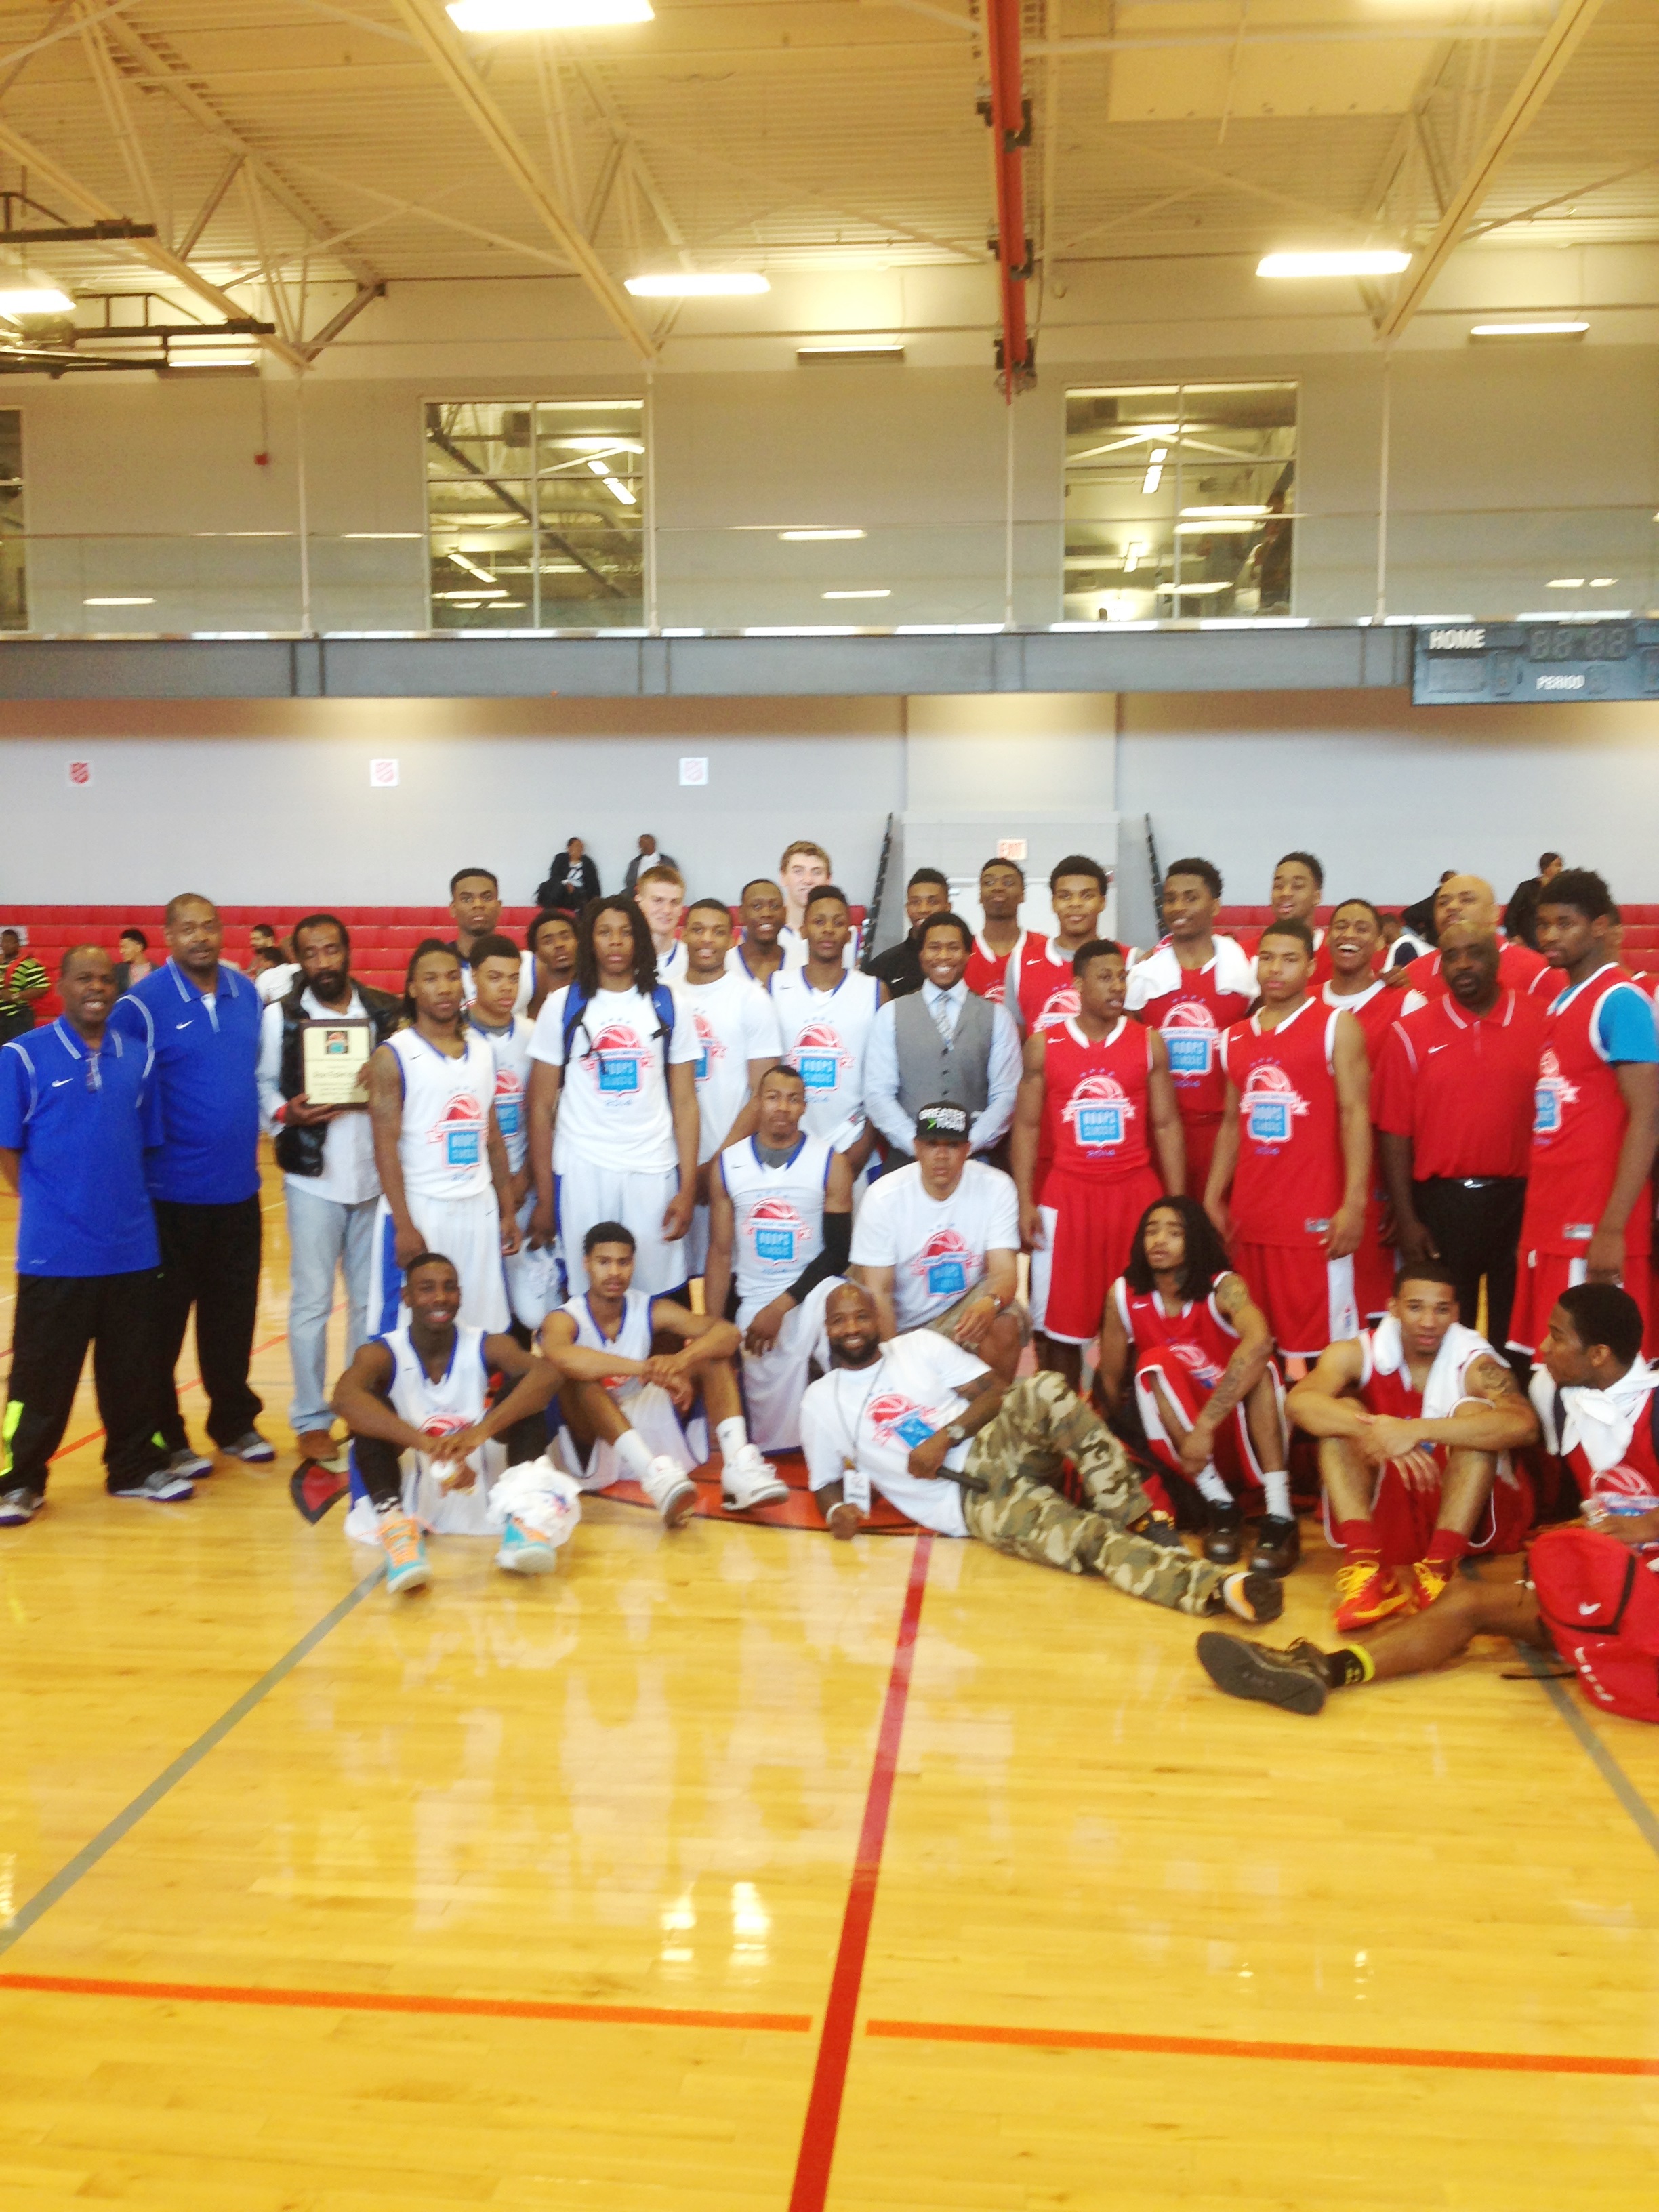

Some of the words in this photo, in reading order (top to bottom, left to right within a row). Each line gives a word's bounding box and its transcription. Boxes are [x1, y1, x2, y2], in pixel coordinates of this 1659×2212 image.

[1429, 628, 1486, 650] HOME
[1536, 674, 1586, 691] PERIOD
[919, 1107, 966, 1121] GREATER
